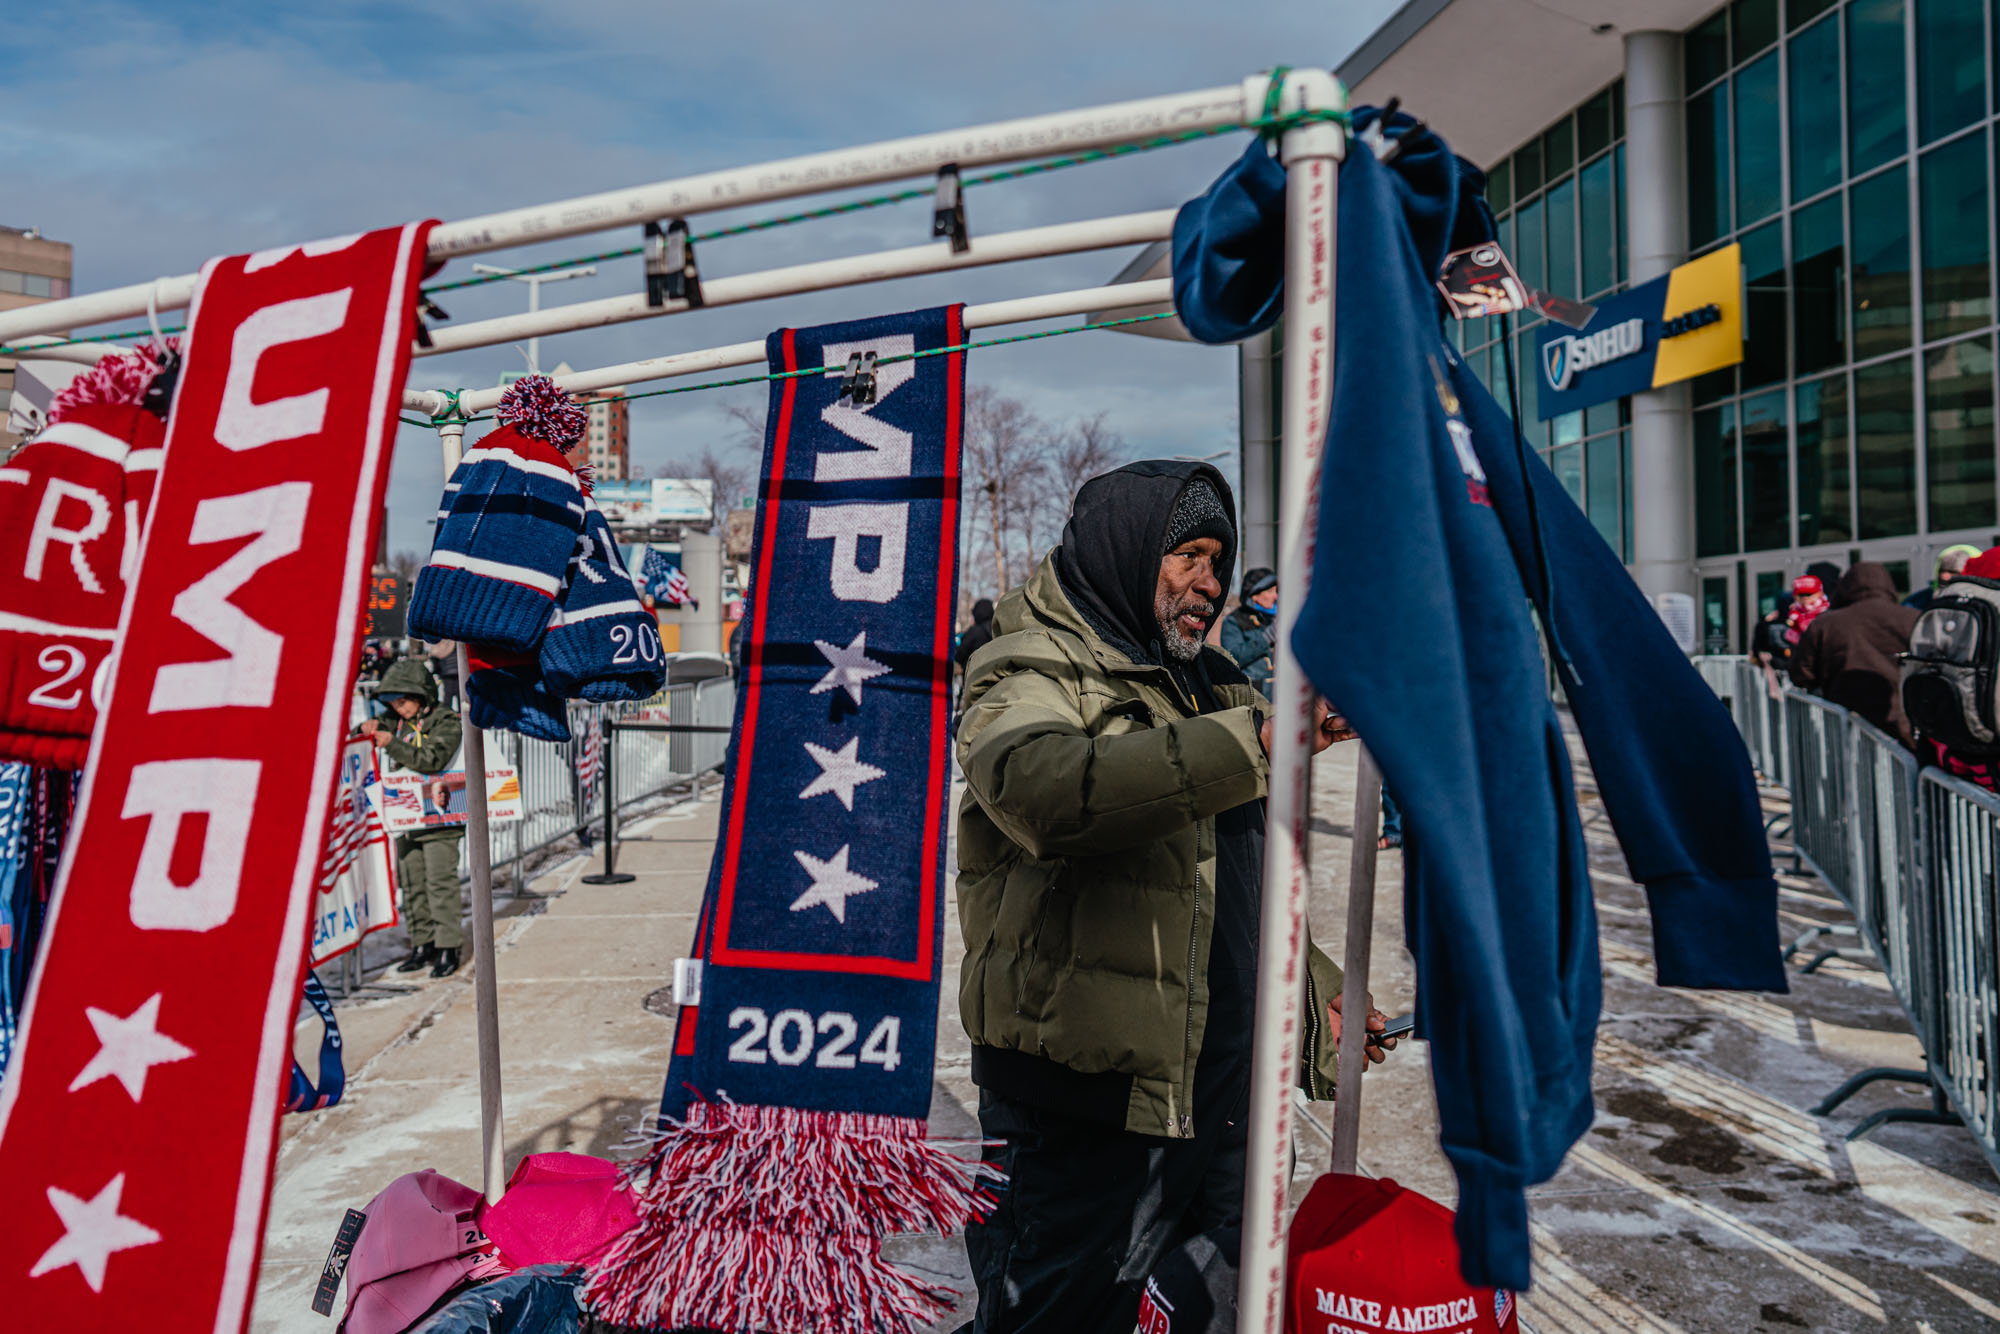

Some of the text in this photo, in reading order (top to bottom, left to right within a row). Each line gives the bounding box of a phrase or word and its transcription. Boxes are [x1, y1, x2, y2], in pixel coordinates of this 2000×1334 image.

[1572, 318, 1643, 372] SNHU
[121, 231, 364, 934] UMP
[609, 622, 665, 667] 20
[728, 1006, 901, 1071] 2024
[1316, 1288, 1478, 1333] MAKE AMERICA
